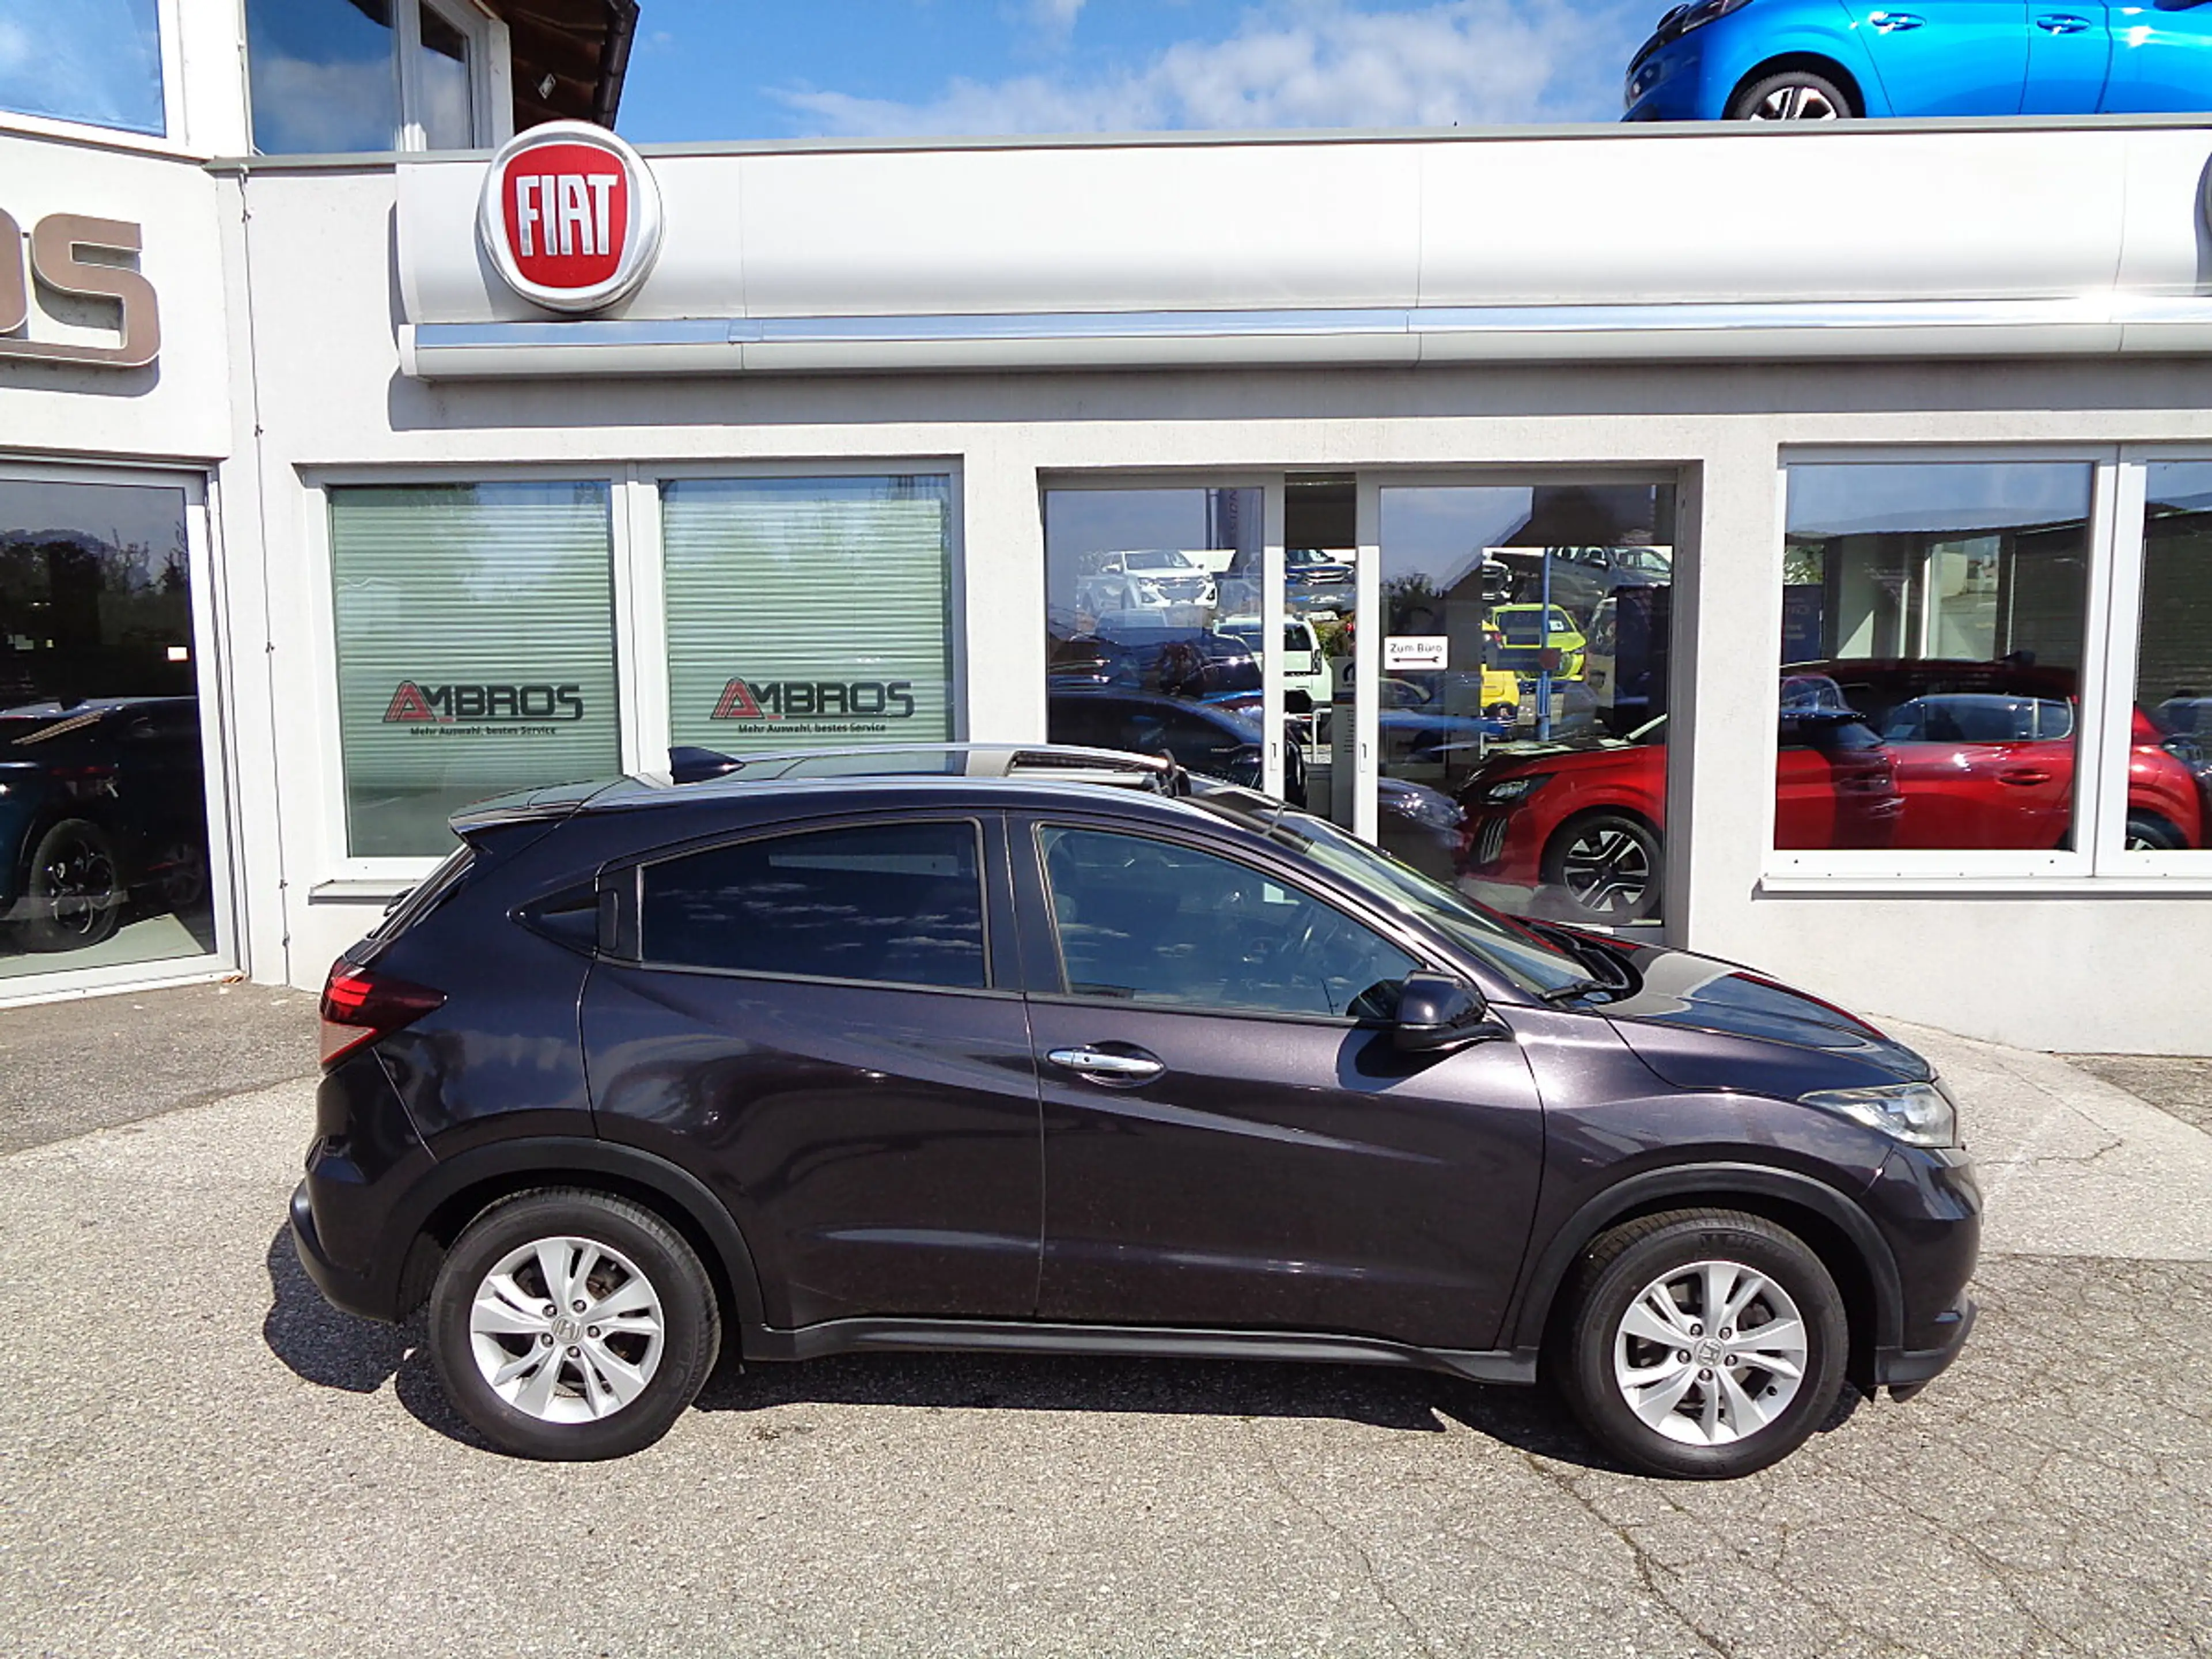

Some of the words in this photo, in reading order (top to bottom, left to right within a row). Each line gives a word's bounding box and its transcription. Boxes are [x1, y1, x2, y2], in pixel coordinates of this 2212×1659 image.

[516, 174, 618, 257] FIAT
[1389, 643, 1414, 653] Zum
[1417, 643, 1442, 653] Büro
[382, 680, 584, 722] AMBROS
[710, 677, 915, 719] AMBROS
[738, 724, 764, 733] Mehr
